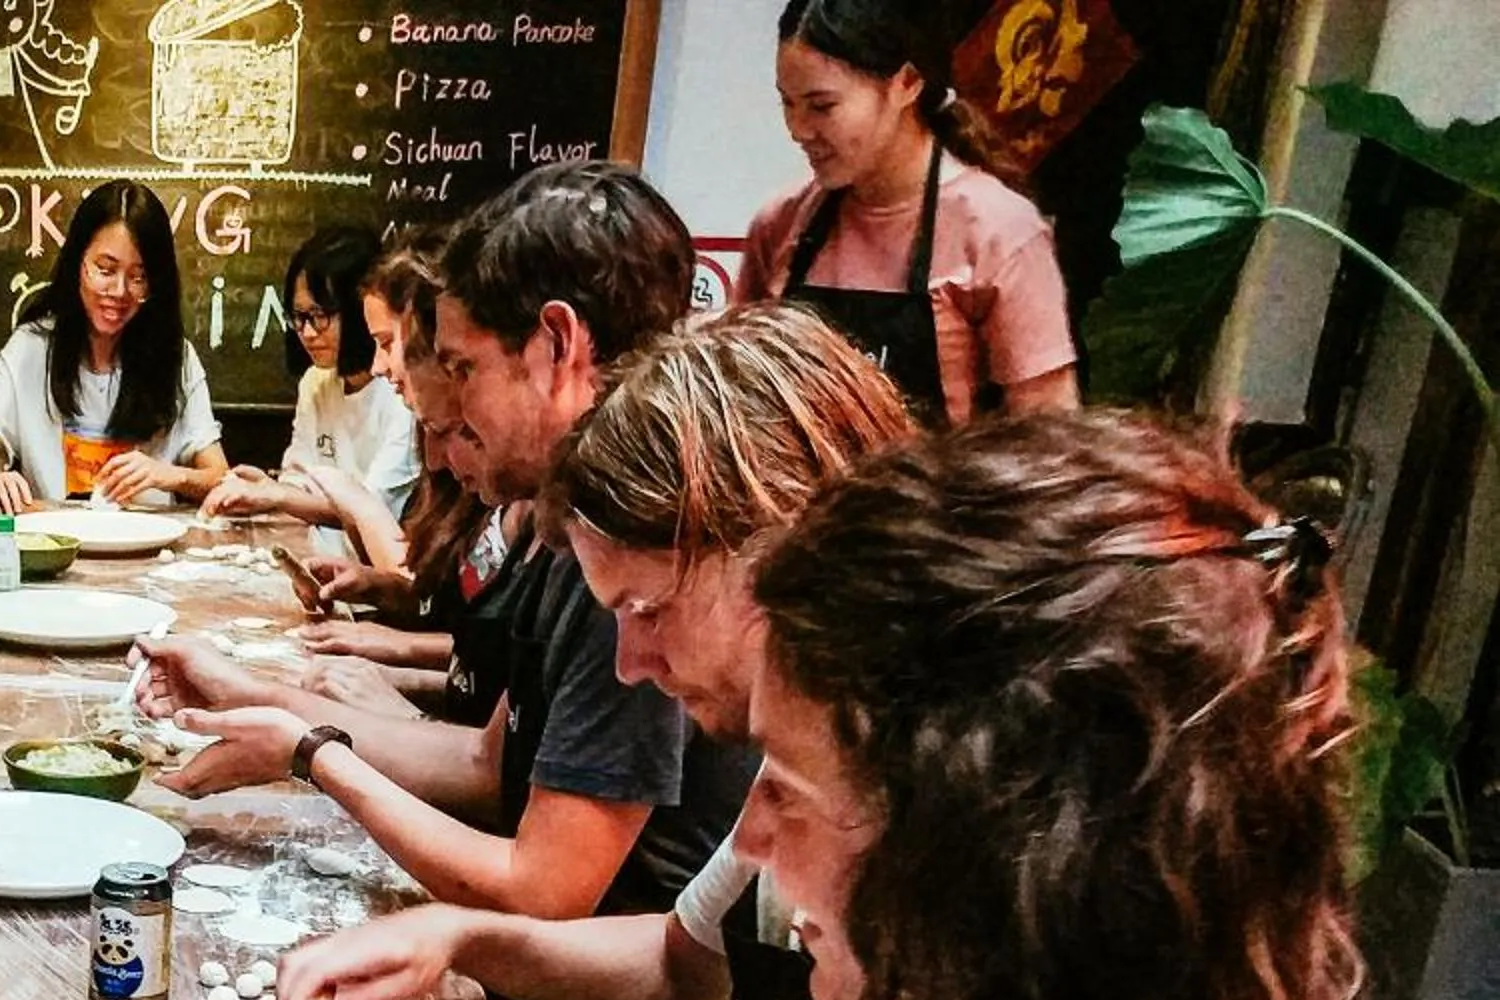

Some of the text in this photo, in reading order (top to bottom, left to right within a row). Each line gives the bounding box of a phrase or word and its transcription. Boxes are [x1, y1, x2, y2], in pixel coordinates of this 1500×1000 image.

[391, 14, 596, 47] Banana Pancake
[395, 69, 491, 110] Pizza
[385, 124, 597, 171] Sichuan Flavor
